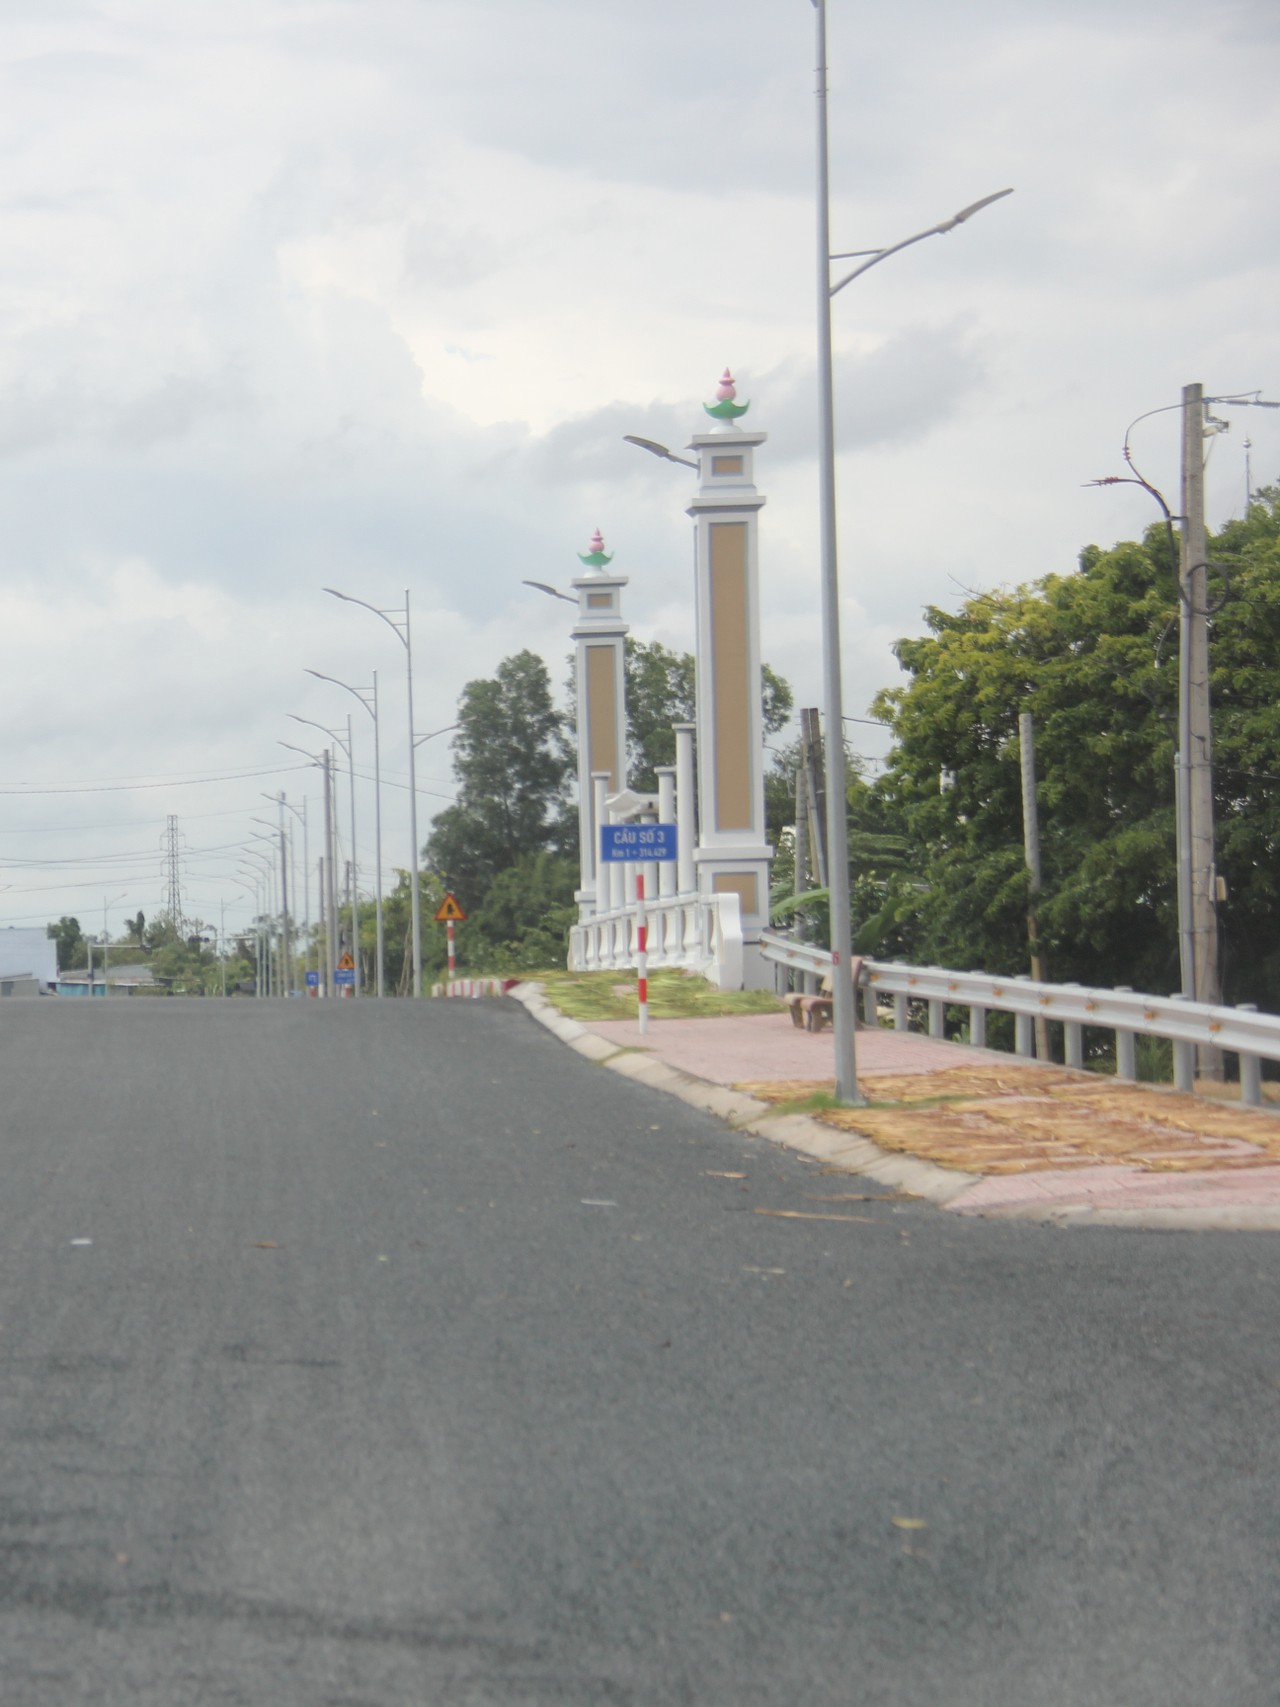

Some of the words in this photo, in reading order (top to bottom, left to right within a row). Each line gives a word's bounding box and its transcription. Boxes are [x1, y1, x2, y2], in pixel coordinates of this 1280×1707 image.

[614, 828, 636, 844] CẦU
[639, 828, 656, 844] SỐ
[657, 831, 664, 843] 3
